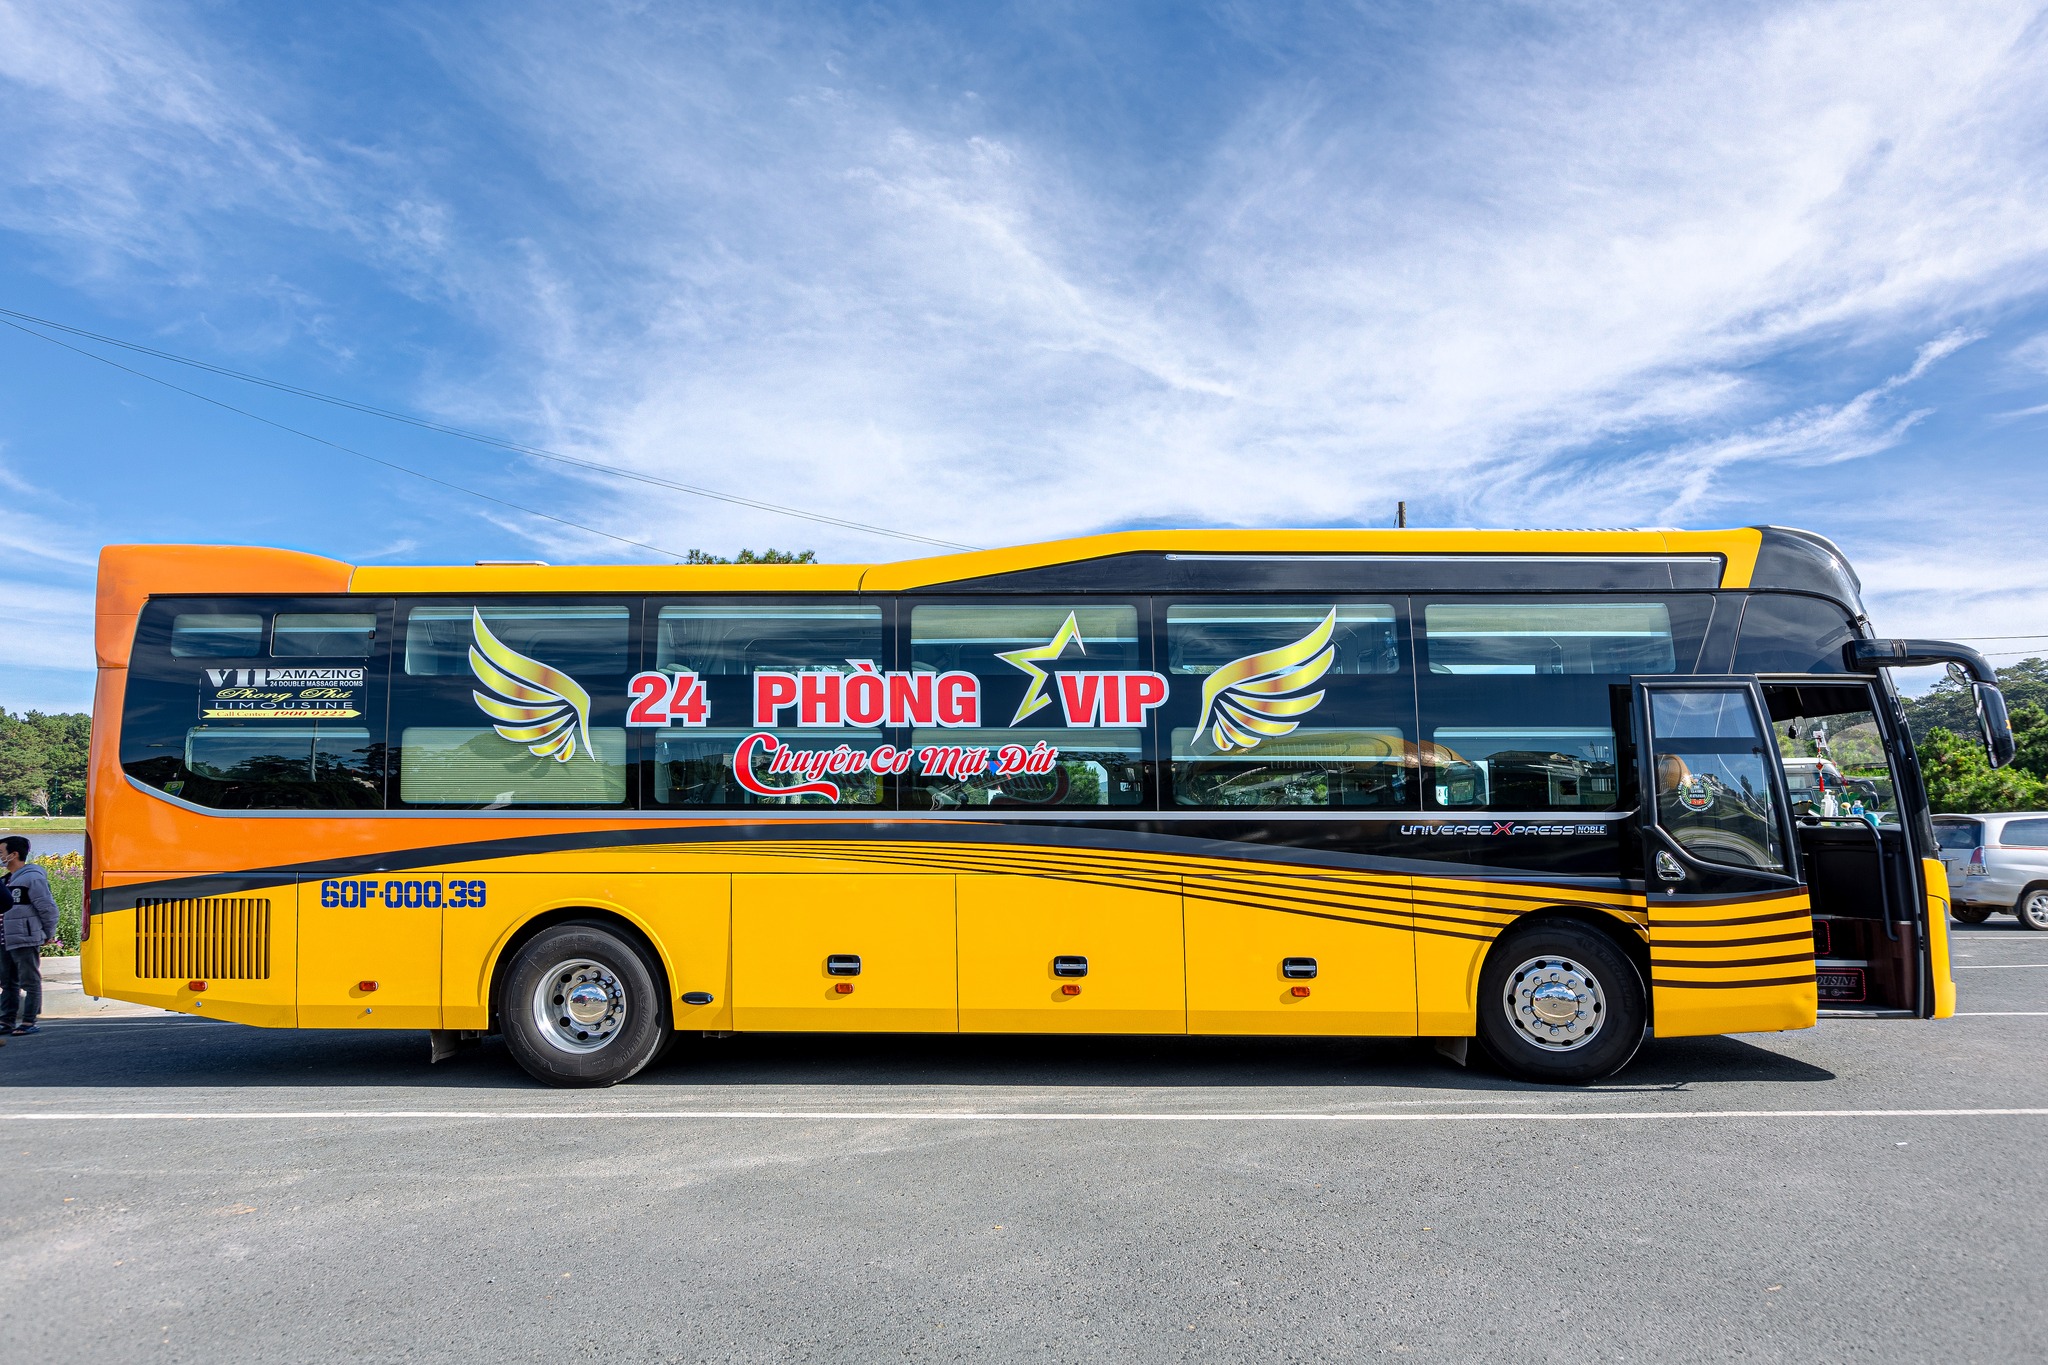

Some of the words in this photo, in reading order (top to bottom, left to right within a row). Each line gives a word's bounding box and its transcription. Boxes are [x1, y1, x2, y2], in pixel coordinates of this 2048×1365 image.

[281, 669, 361, 679] AMAZING
[216, 687, 294, 703] Phong
[625, 671, 711, 727] 24
[753, 658, 981, 728] PHÒNG
[1055, 670, 1169, 728] VIP
[215, 702, 353, 710] LIMOUSINE
[733, 732, 866, 804] Chuyên
[871, 744, 911, 776] Cơ
[918, 744, 990, 784] Mặt
[993, 740, 1058, 775] Đất
[1577, 825, 1605, 834] NOBLE
[1816, 975, 1858, 987] OUSINE
